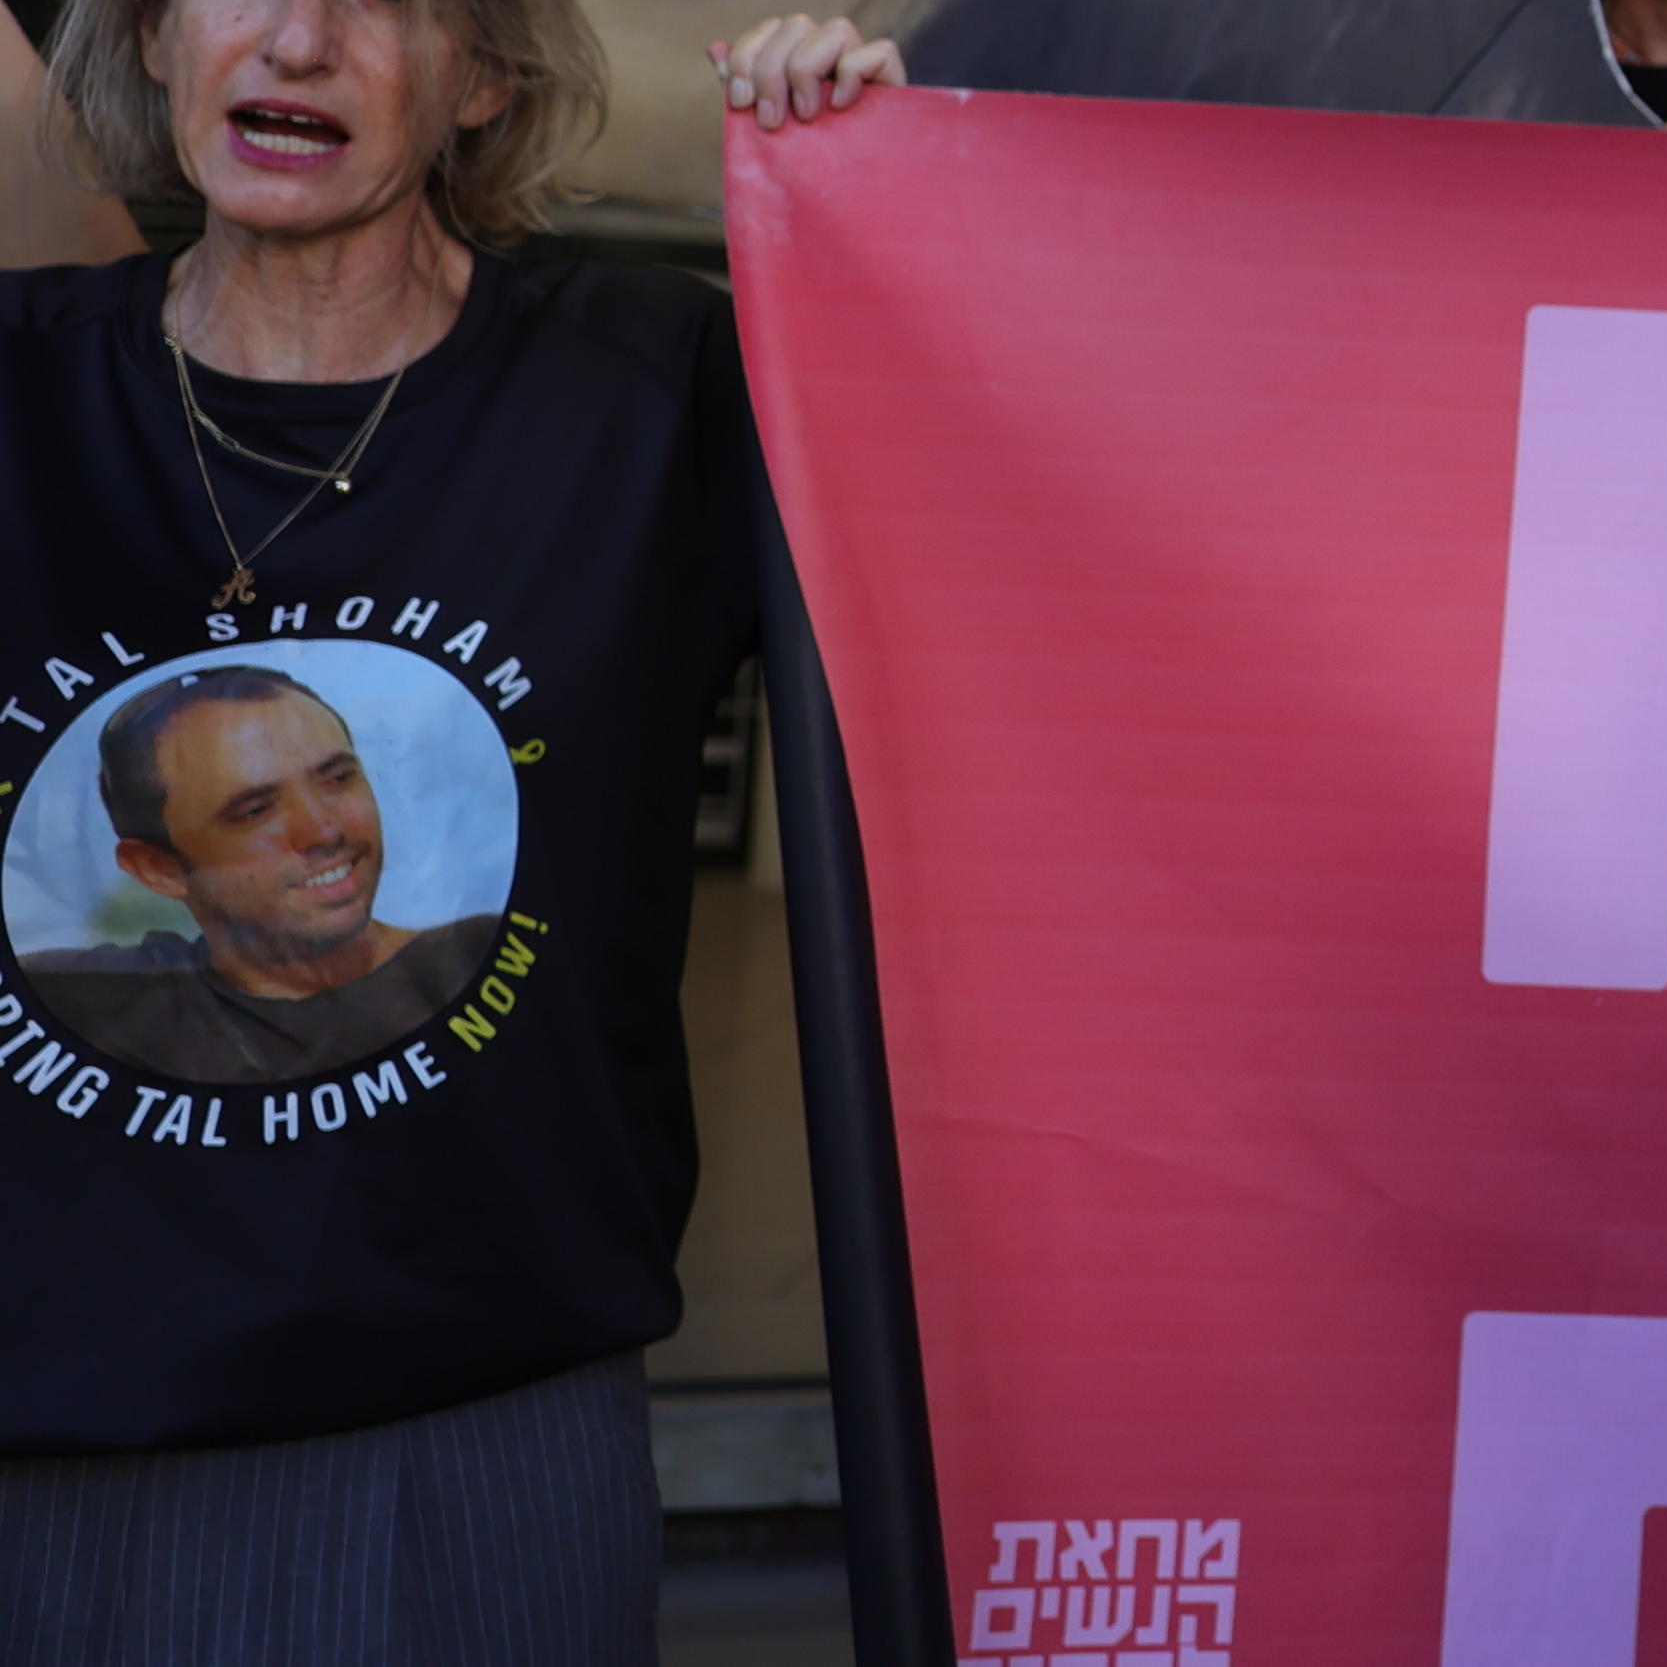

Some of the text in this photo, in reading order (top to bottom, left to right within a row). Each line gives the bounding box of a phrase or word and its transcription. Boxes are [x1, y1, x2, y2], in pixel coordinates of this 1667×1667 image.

[0, 595, 532, 735] TAL SHOHAM
[124, 1085, 227, 1148] TAL
[262, 1041, 447, 1146] HOME
[447, 910, 549, 1053] NOW!
[988, 1518, 1242, 1583] מחאת
[968, 1584, 1237, 1652] הנשים
